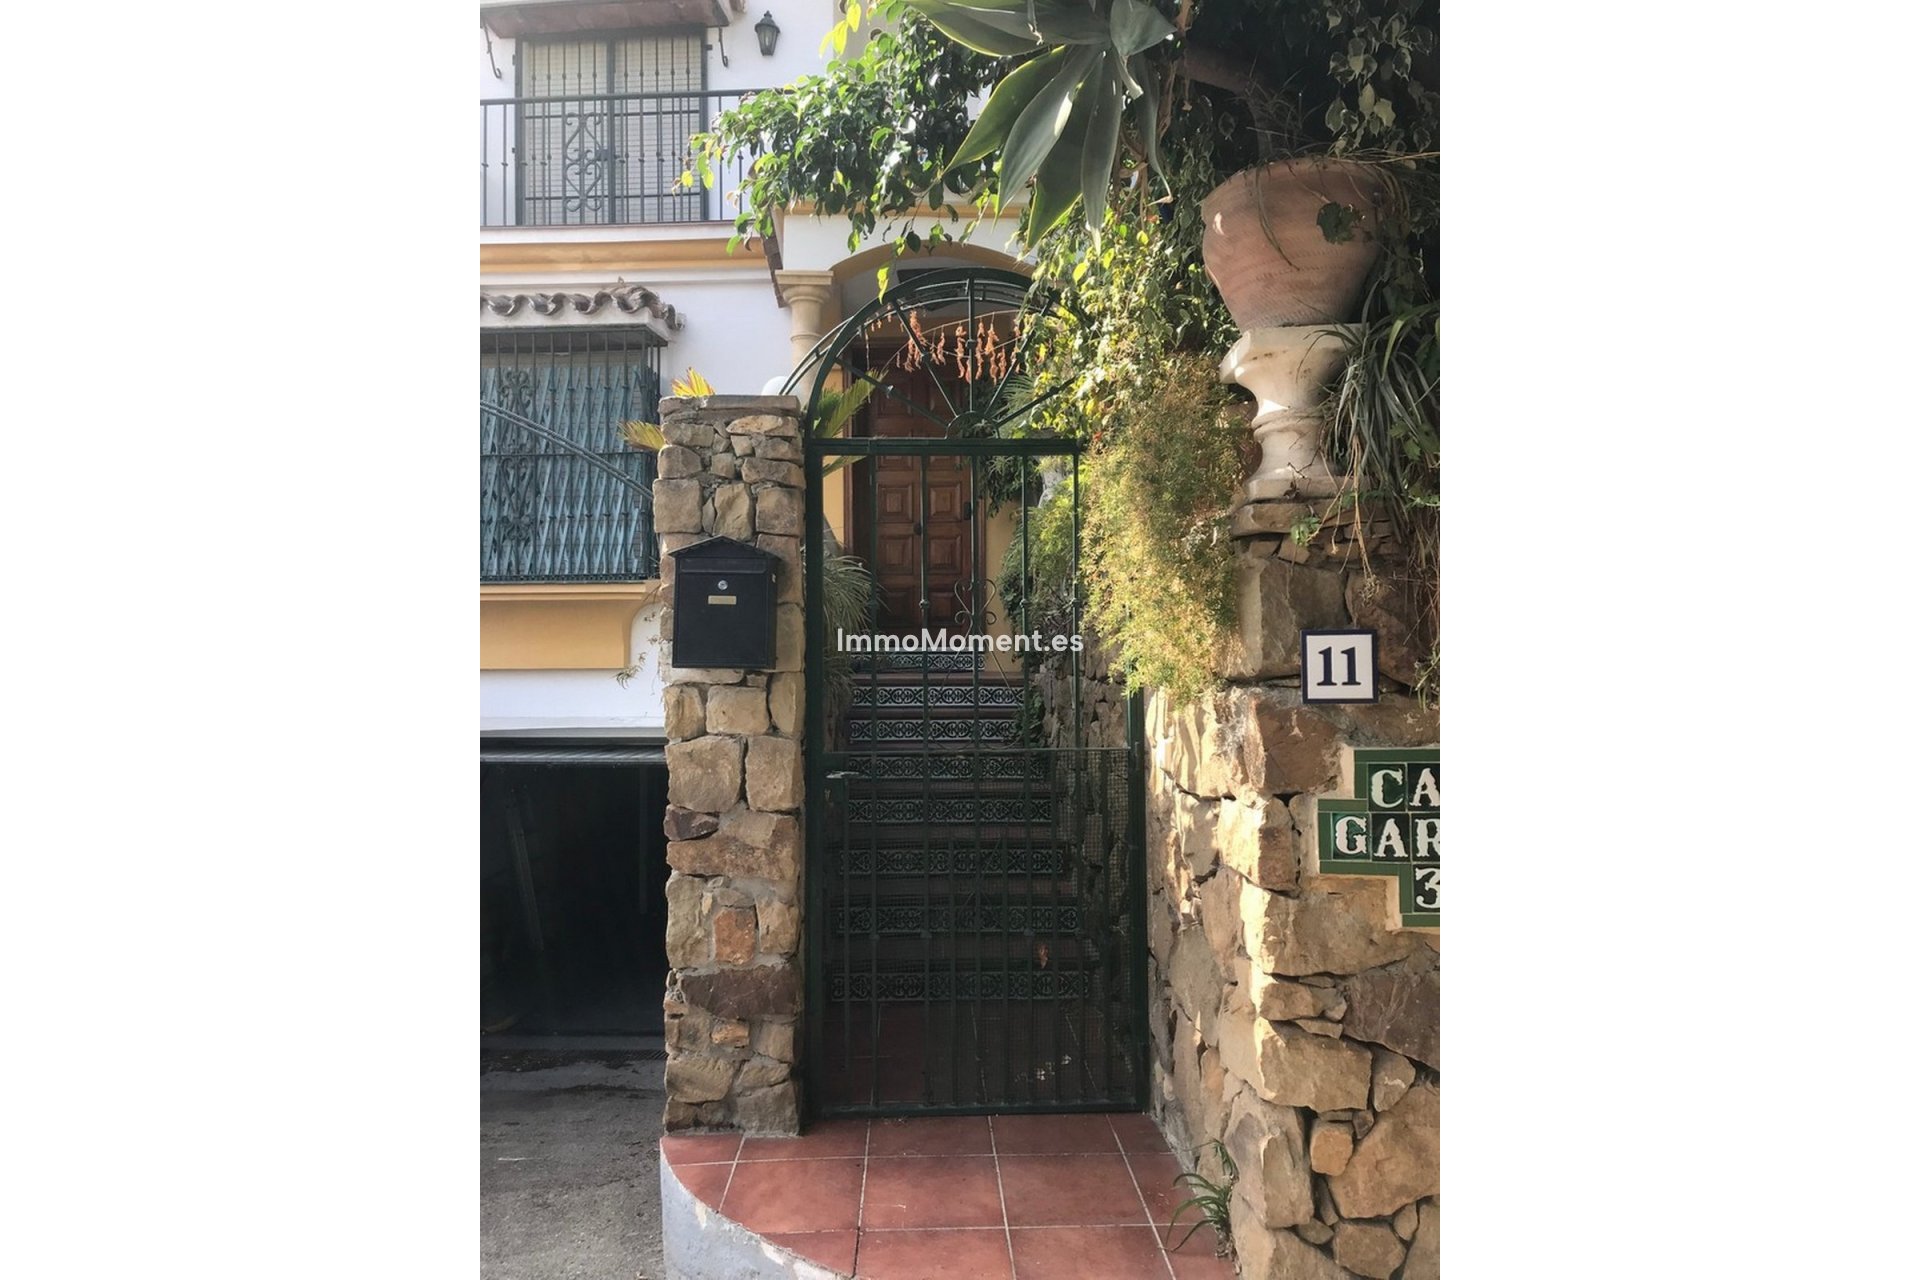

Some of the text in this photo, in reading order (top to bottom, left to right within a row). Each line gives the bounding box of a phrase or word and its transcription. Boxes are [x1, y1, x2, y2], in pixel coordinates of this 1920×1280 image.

[1316, 646, 1361, 686] 11
[1371, 768, 1440, 808] CA
[1335, 816, 1440, 858] GAR
